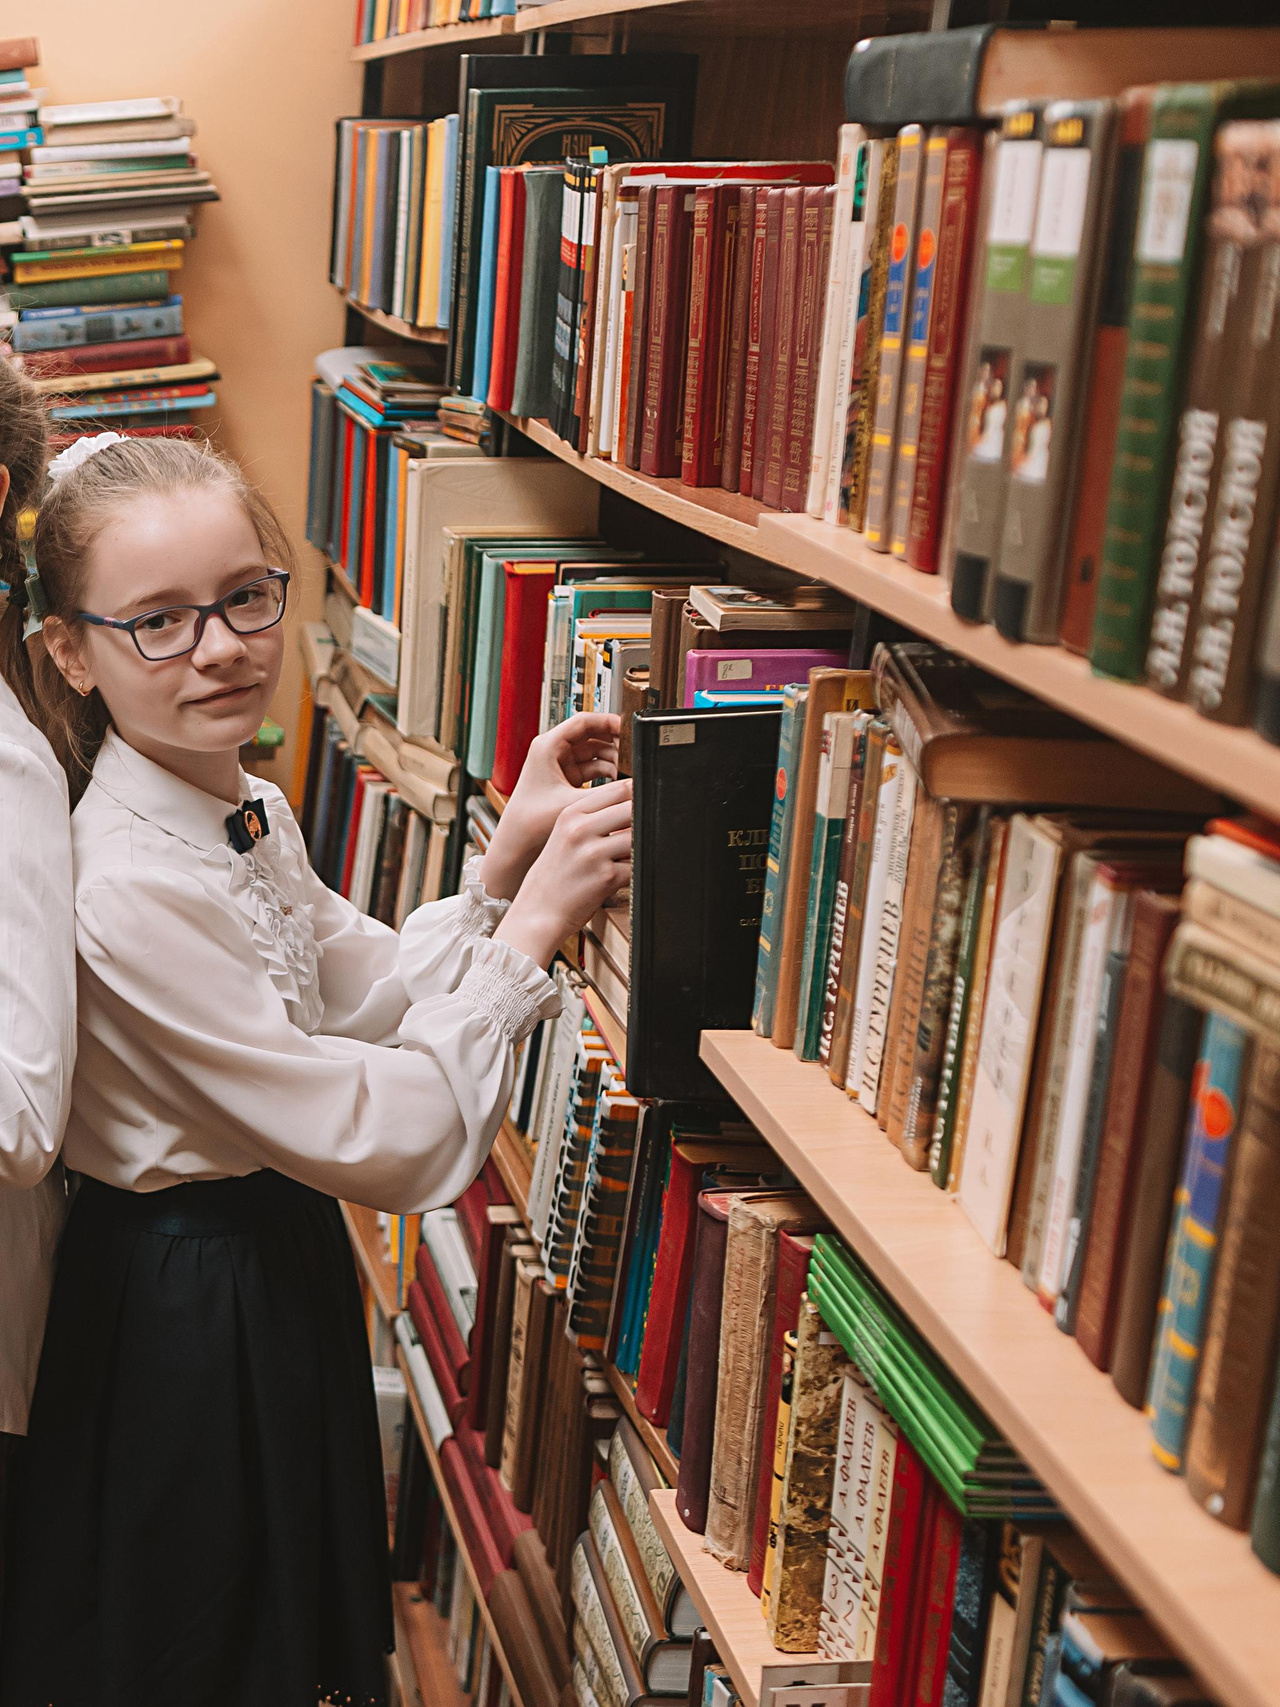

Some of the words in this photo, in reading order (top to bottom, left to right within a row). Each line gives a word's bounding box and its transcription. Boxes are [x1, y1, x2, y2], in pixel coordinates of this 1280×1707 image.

[836, 359, 847, 406] КАЗАКИ
[1157, 407, 1219, 599] ТОЛСТОЙ
[1200, 416, 1268, 613] ТОЛСТОЙ
[825, 879, 849, 1004] ТУРГЕНЕВ
[868, 899, 901, 1036] ТУРГЕНЕВ
[839, 1397, 858, 1483] ФАДЕЕВ
[856, 1420, 876, 1508] ФАДЕЕВ
[873, 1449, 891, 1536] ФАДЕЕВ
[830, 1573, 839, 1600] 3
[842, 1598, 855, 1626] 2
